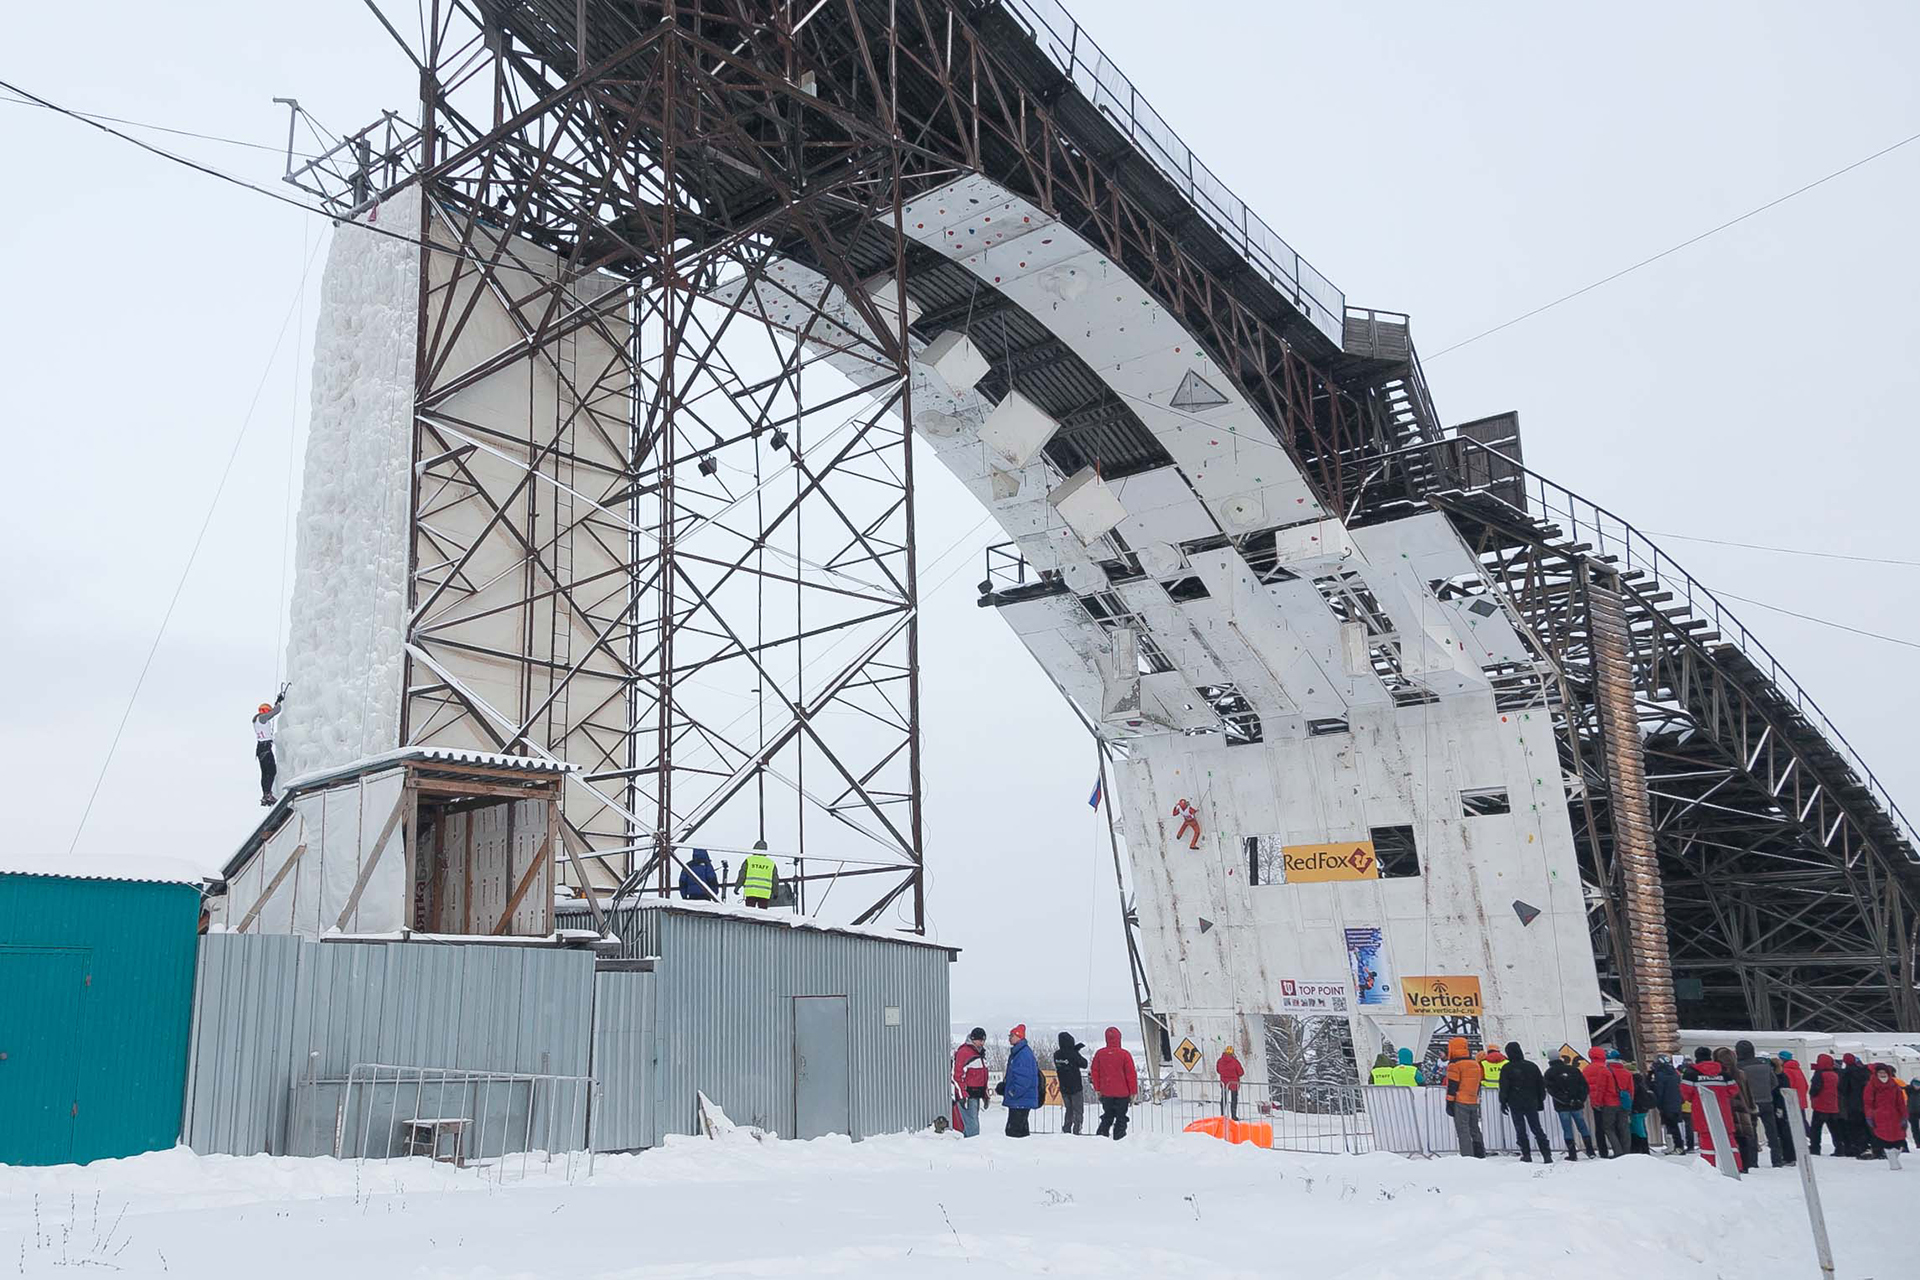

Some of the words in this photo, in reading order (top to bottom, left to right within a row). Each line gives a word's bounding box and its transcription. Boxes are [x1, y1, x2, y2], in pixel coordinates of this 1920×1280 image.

[1299, 986, 1316, 995] TOP
[1318, 986, 1344, 995] POINT
[1407, 992, 1478, 1006] Vertical
